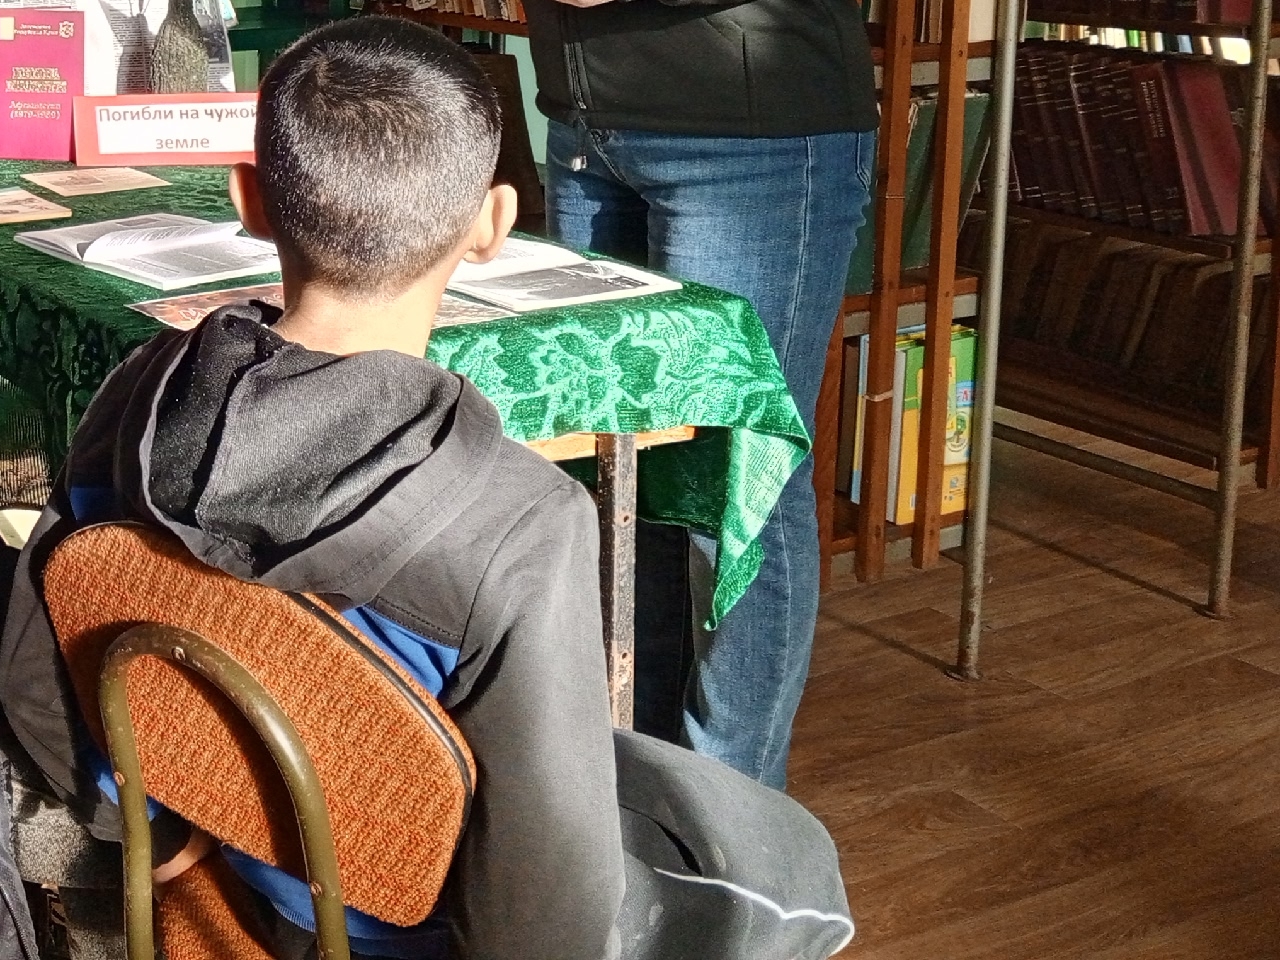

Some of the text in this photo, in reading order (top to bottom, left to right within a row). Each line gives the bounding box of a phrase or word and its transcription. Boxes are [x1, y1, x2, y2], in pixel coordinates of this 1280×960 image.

[99, 106, 173, 122] Погибли
[180, 109, 199, 119] на
[156, 138, 209, 150] земле
